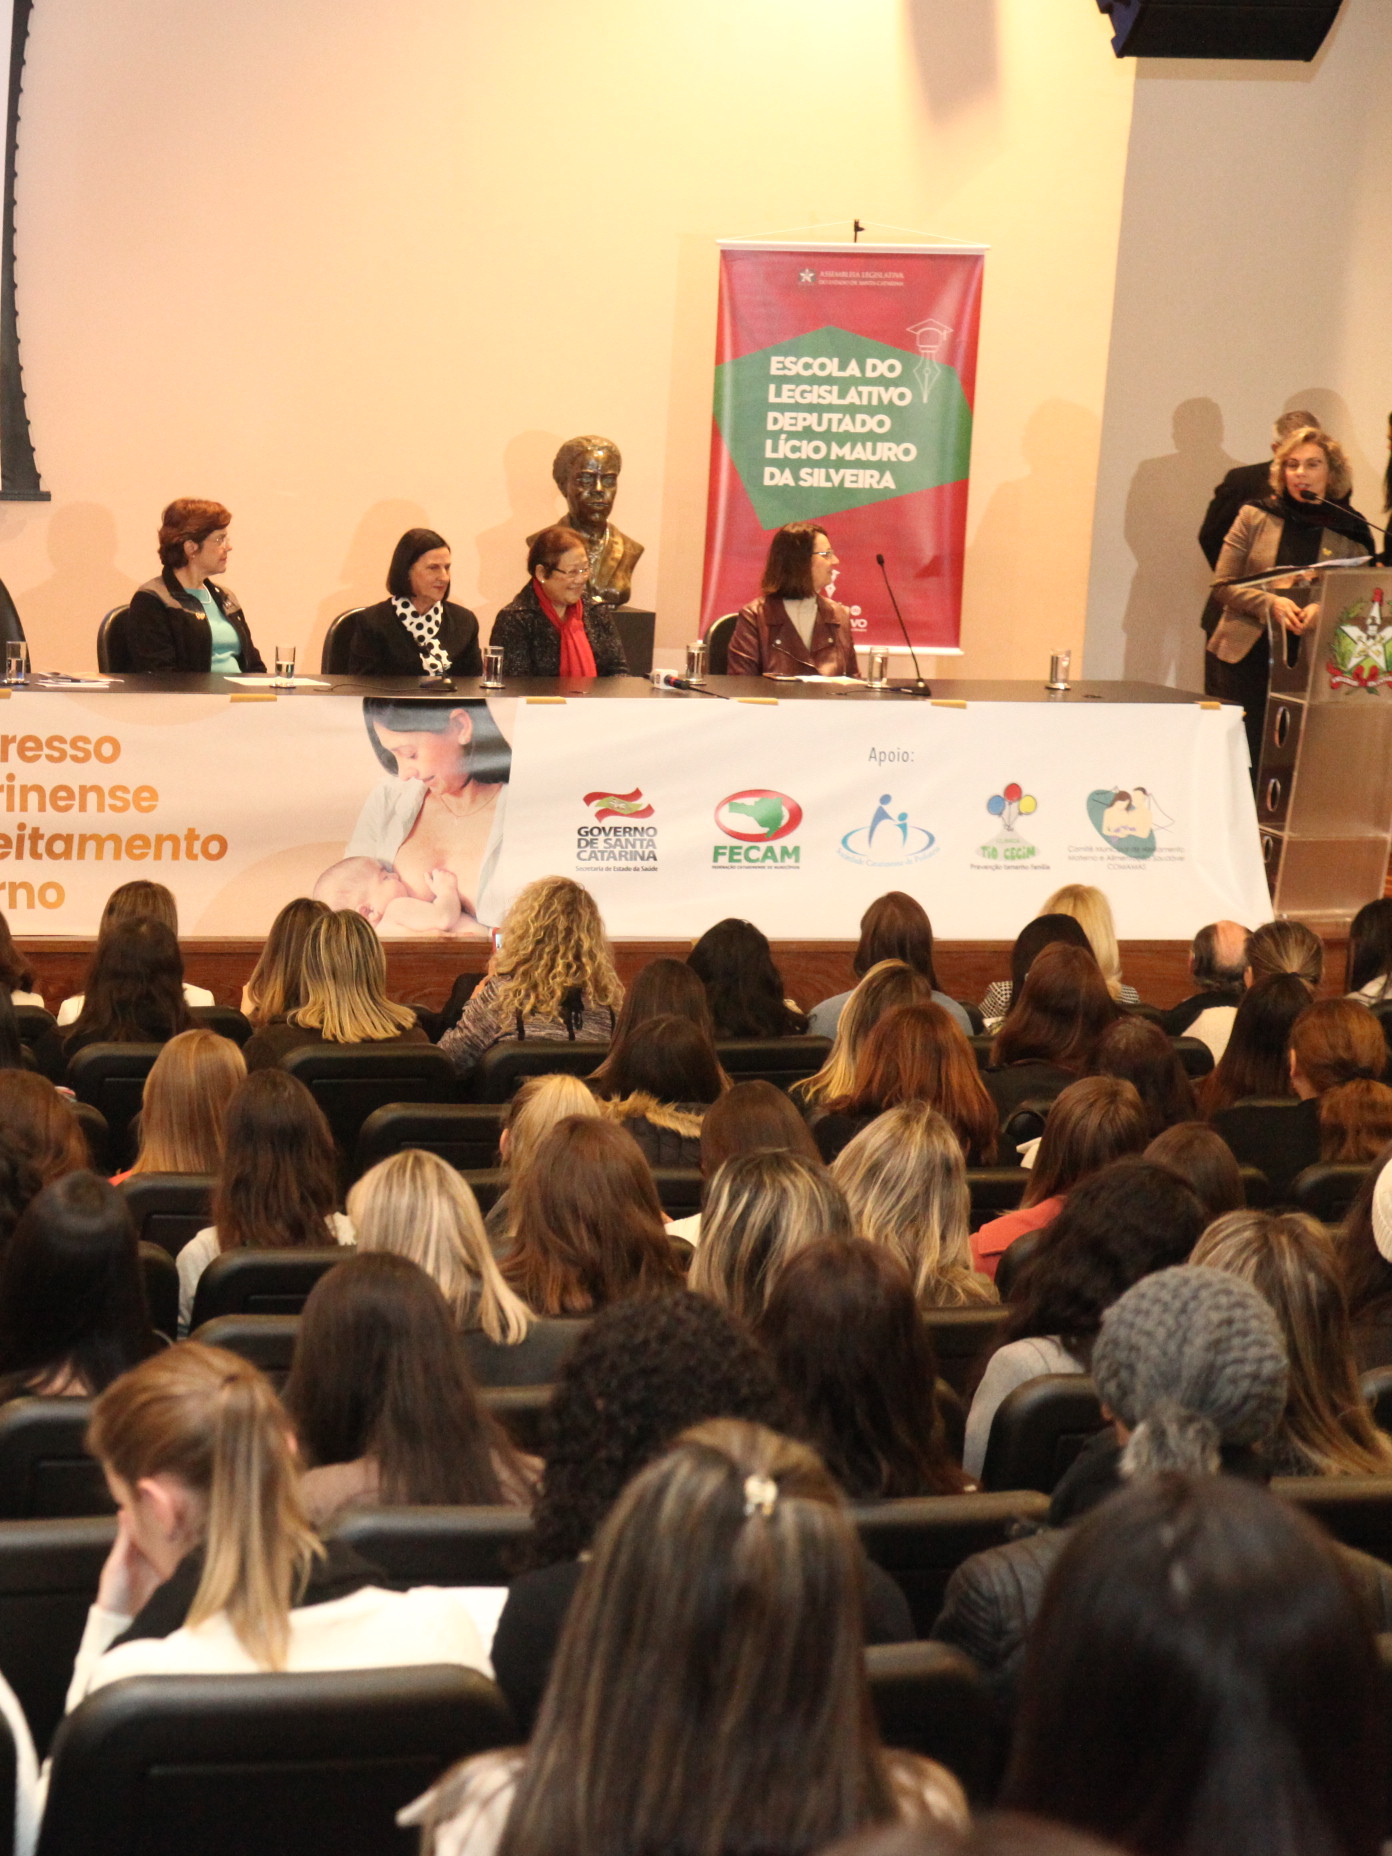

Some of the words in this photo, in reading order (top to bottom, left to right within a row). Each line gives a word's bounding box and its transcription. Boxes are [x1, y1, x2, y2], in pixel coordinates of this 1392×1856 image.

[770, 356, 862, 378] ESCOLA
[865, 358, 903, 378] DO
[768, 383, 913, 407] LEGISLATIVO
[766, 411, 892, 434] DEPUTADO
[764, 433, 827, 460] LÍCIO
[830, 442, 917, 462] MAURO
[763, 466, 795, 486] DA
[798, 467, 897, 489] SILVEIRA
[868, 747, 915, 766] Apoio:
[577, 826, 658, 838] GOVERNO
[577, 838, 599, 849] DE
[603, 838, 657, 849] SANTA
[576, 850, 658, 861] CATARINA
[712, 845, 800, 863] FECAM
